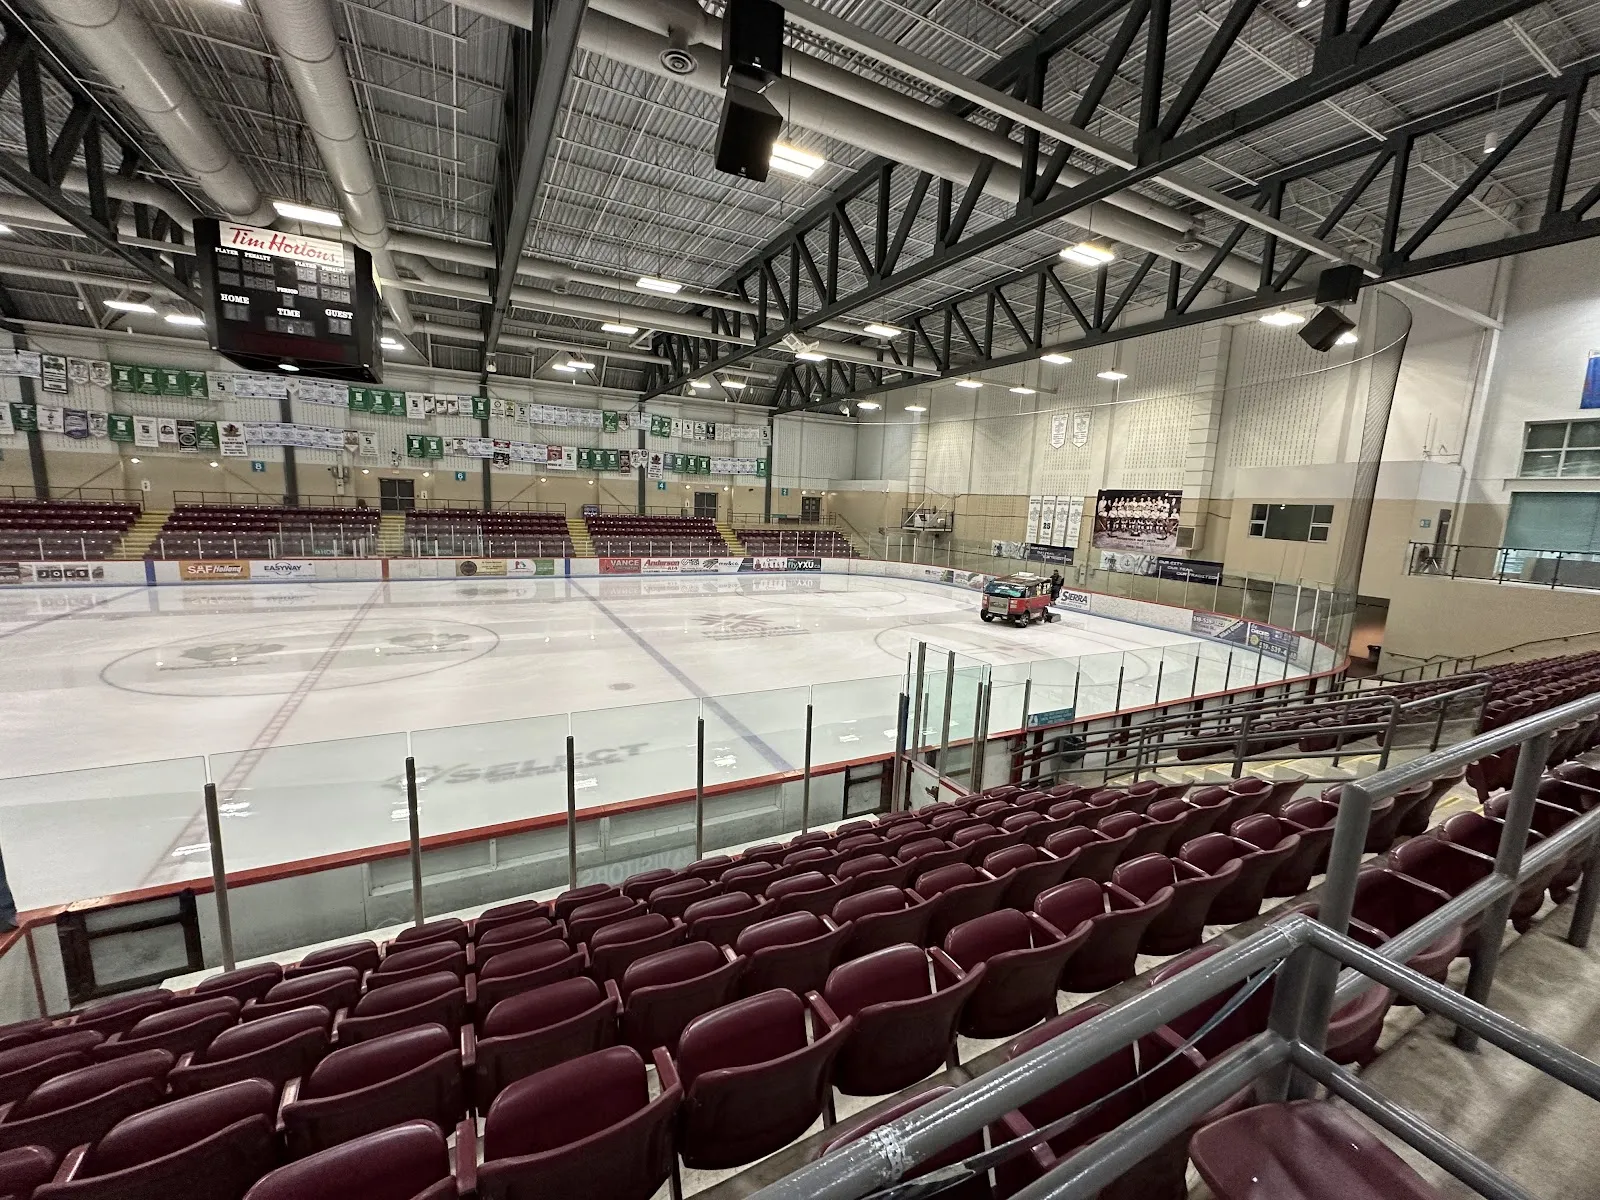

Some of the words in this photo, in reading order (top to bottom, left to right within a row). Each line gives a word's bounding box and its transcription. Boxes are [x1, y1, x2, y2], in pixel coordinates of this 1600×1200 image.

[229, 227, 265, 249] Tim
[215, 247, 239, 256] PLAYER
[244, 251, 271, 262] PENALTY
[294, 260, 317, 269] PLAYER
[276, 286, 299, 295] PERIOD
[220, 293, 250, 305] HOME
[276, 307, 301, 318] TIME
[324, 308, 354, 320] GUEST
[643, 559, 680, 567] Anderson
[187, 564, 213, 574] SAF
